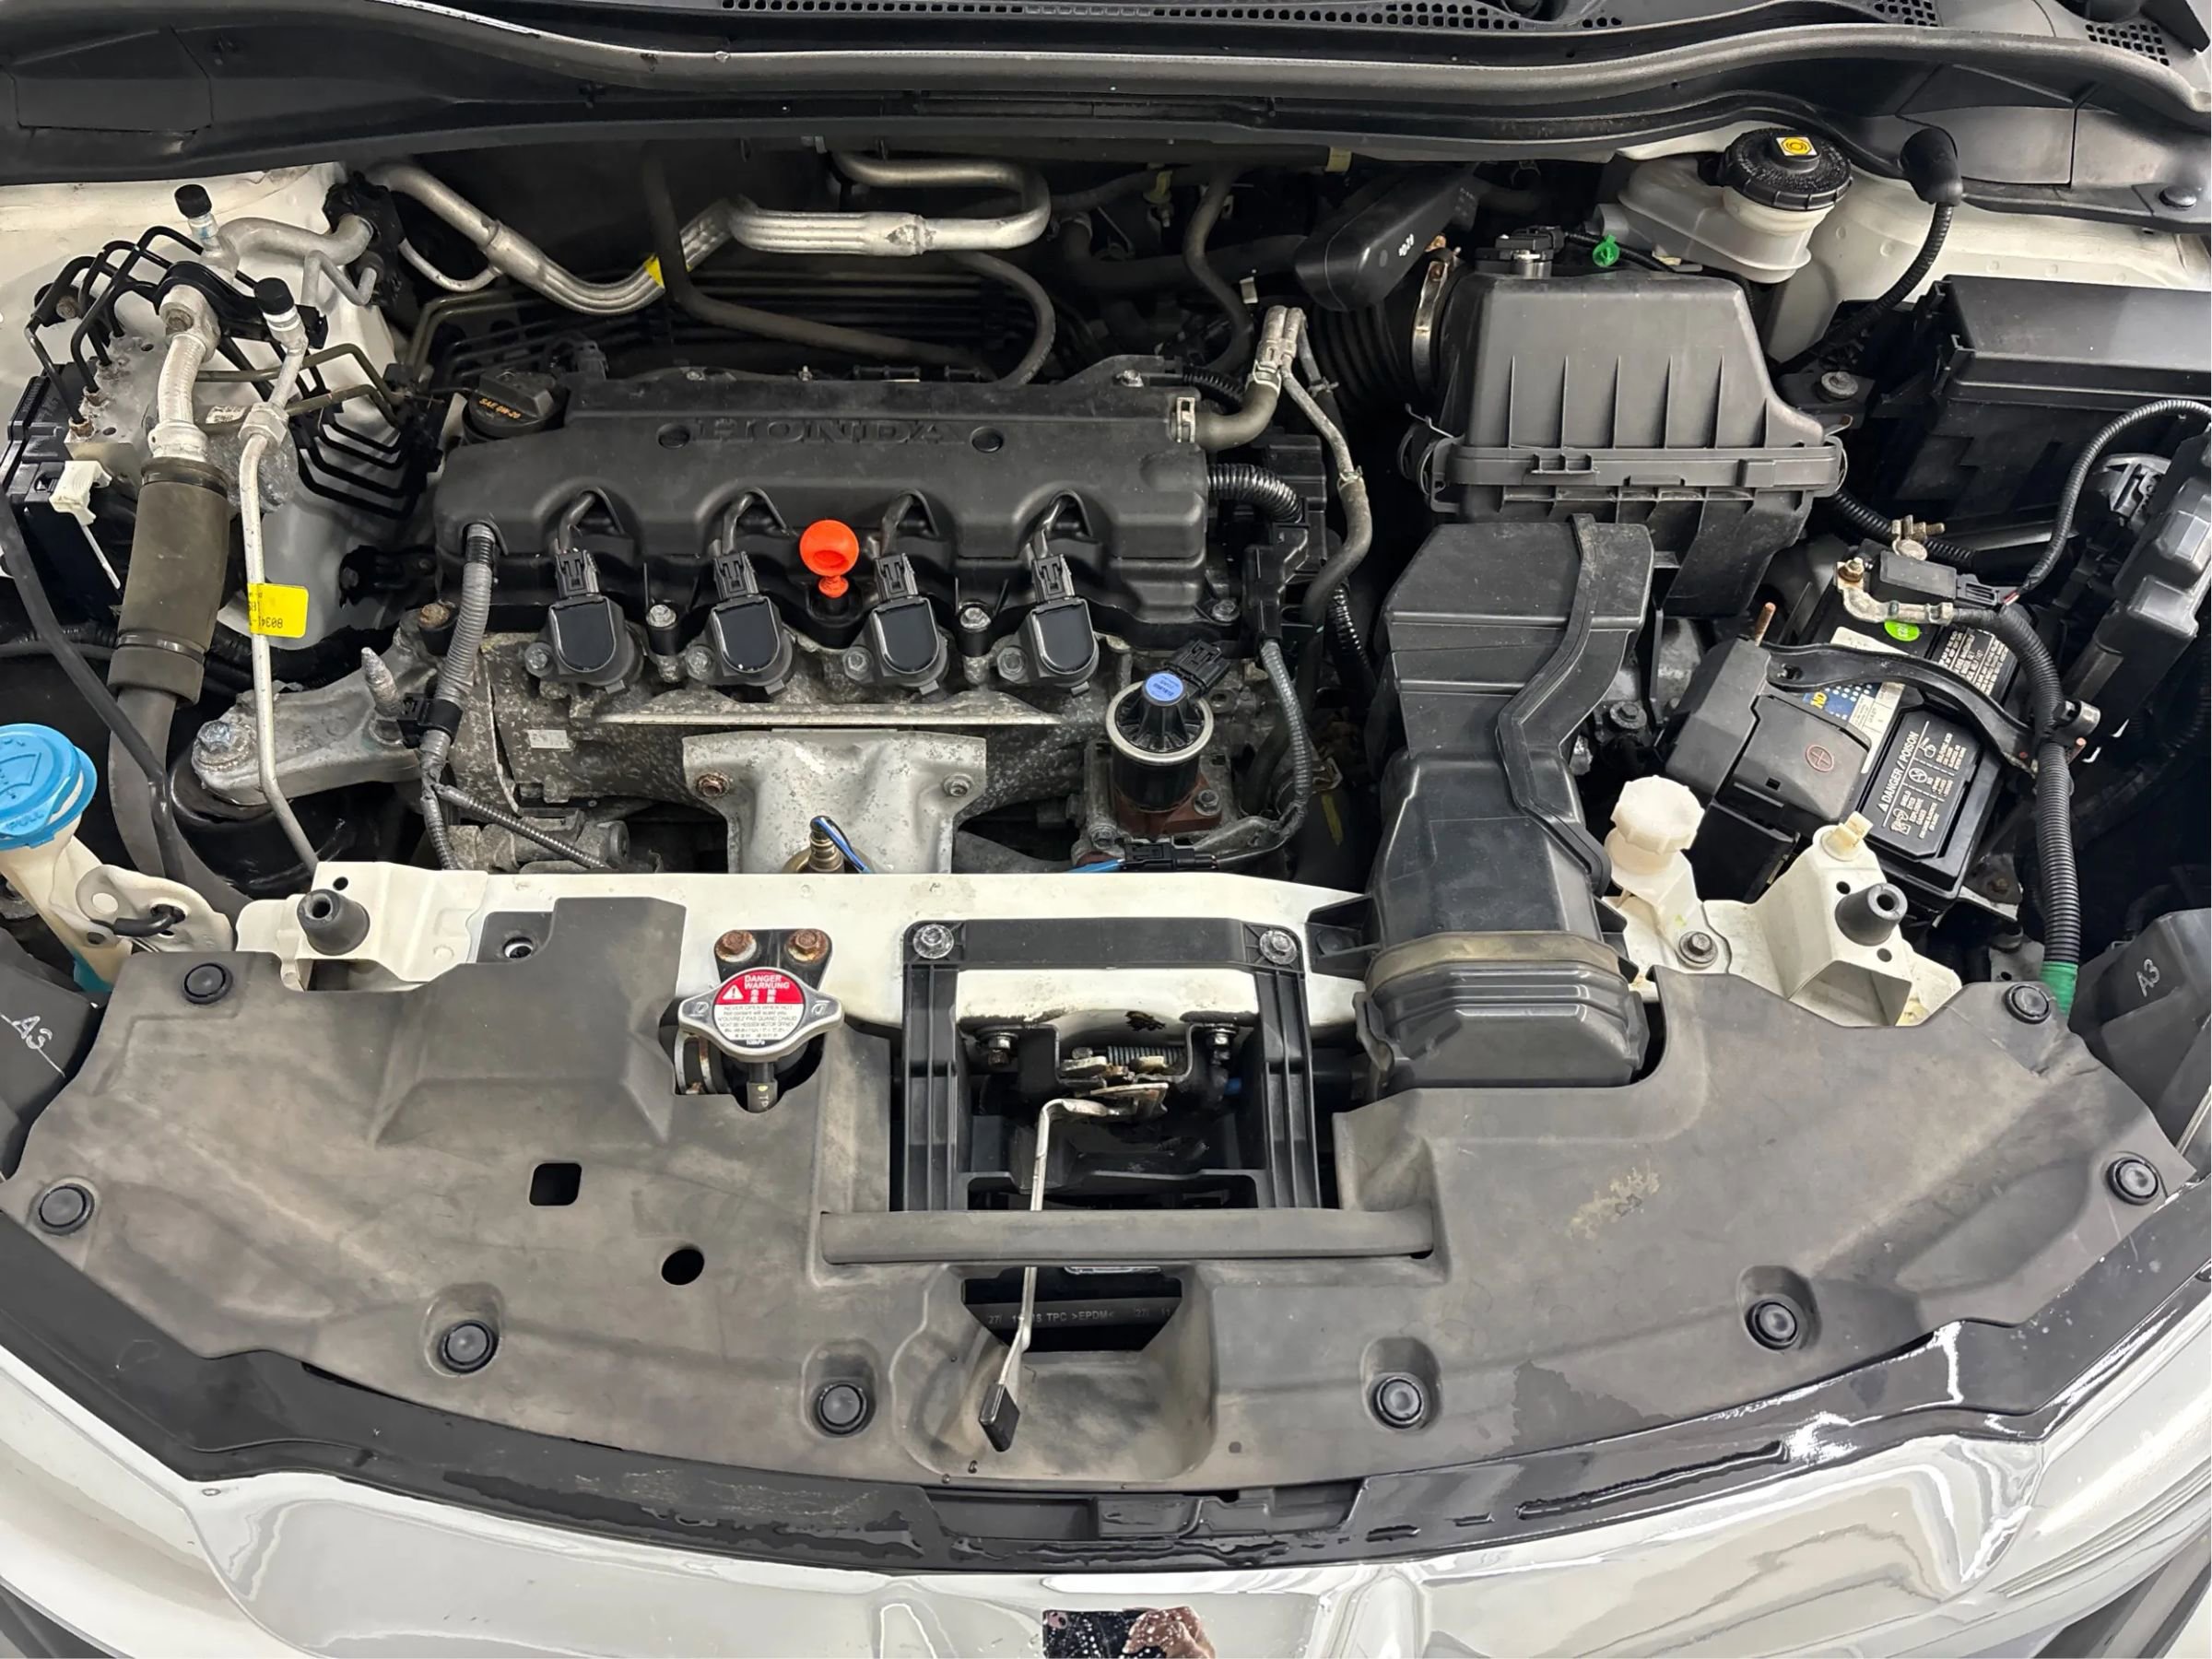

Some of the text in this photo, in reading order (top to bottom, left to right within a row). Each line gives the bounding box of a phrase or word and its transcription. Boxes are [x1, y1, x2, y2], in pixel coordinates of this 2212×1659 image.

[691, 418, 966, 444] HONDA
[1880, 768, 1904, 805] DANGER
[1899, 730, 1920, 763] POISON
[745, 974, 782, 982] DANGER
[745, 982, 790, 990] WARNUNG
[2136, 959, 2160, 997] A3
[1046, 1312, 1067, 1323] TPC
